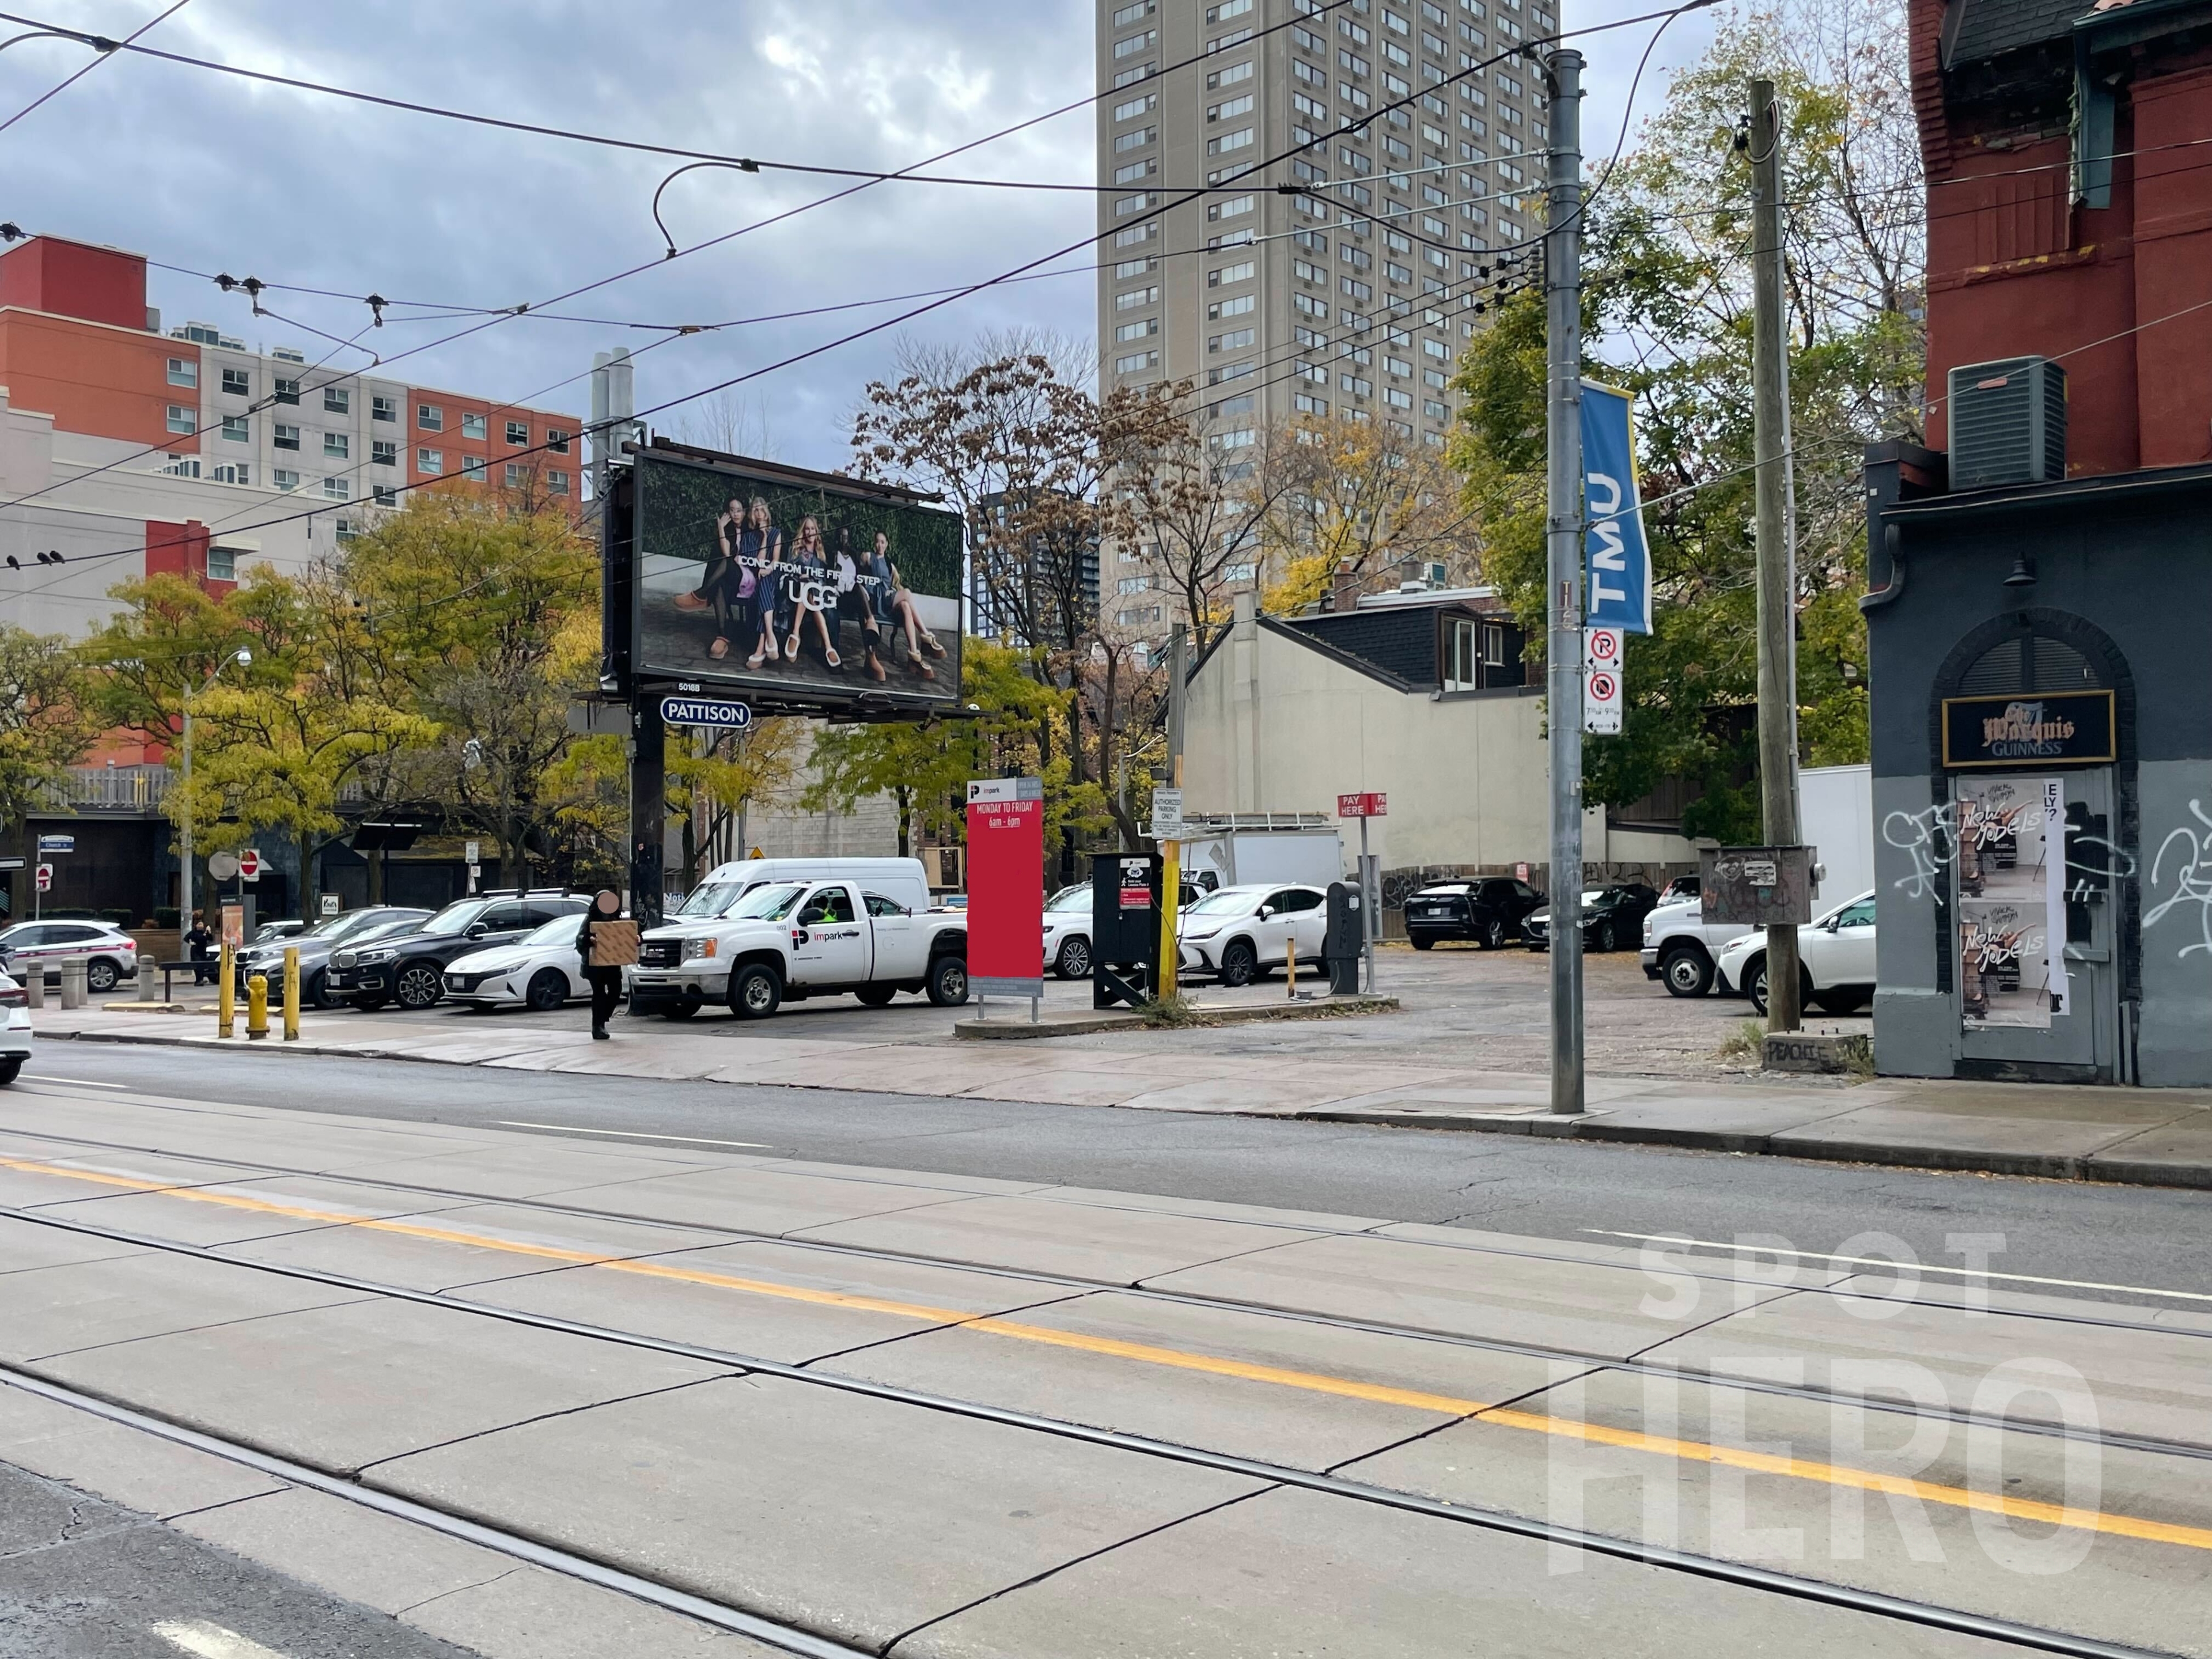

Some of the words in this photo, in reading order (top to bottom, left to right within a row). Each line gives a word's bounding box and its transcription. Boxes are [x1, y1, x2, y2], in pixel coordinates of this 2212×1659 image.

[1586, 473, 1626, 614] TMU
[738, 555, 770, 568] ICONIC
[774, 561, 801, 574] FROM
[804, 566, 824, 578] THE
[857, 574, 880, 586] STEP
[789, 581, 836, 611] UGG
[669, 703, 744, 723] PATTISON
[1982, 716, 2074, 747] Marquis
[1992, 741, 2062, 756] GUINNESS
[1343, 796, 1359, 805] PAY
[1377, 795, 1386, 804] PA
[976, 803, 1001, 815] MONDAY
[1003, 802, 1010, 813] TO
[1012, 801, 1033, 812] FRIDAY
[1342, 805, 1364, 815] HERE
[989, 817, 1001, 827] 6am
[1007, 816, 1020, 828] 6pm
[663, 892, 685, 901] Noti
